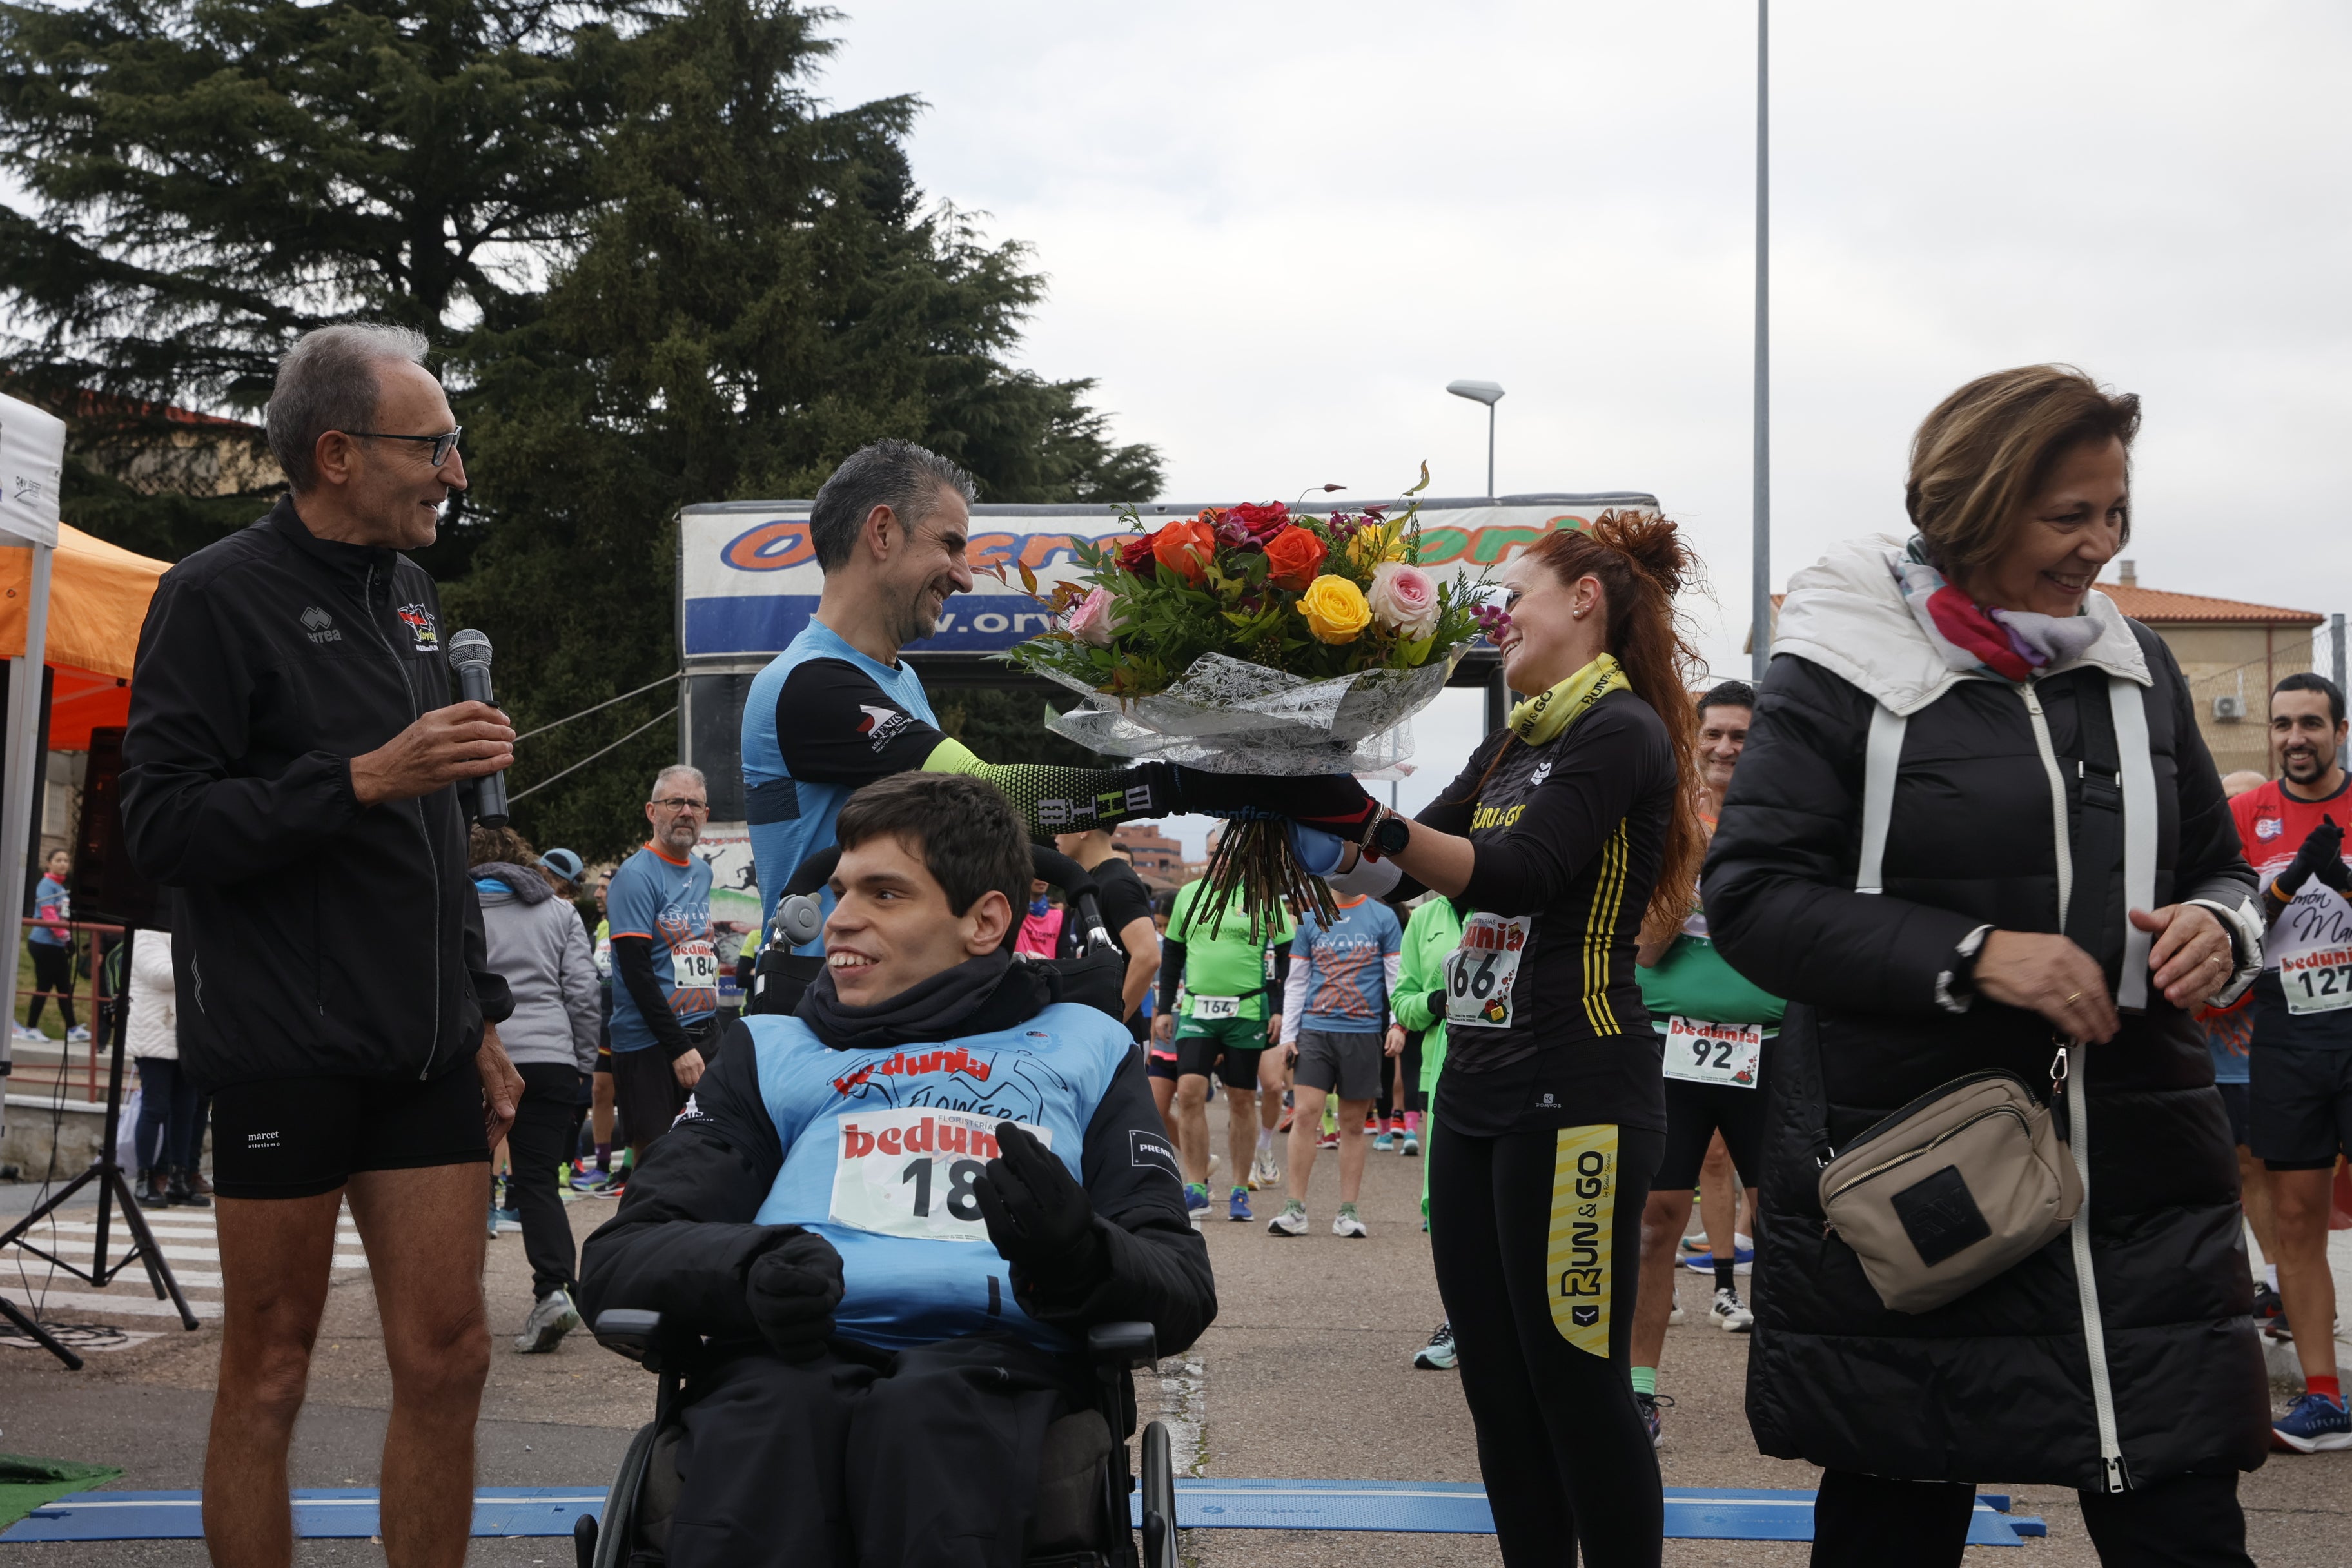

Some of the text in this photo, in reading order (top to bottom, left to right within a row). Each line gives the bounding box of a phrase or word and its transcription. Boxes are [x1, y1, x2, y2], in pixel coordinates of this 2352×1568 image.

[1533, 691, 1553, 712] GO
[870, 713, 903, 740] TEMIS
[1496, 811, 1506, 825] &
[684, 956, 714, 977] 184
[2281, 946, 2352, 972] beduni
[2298, 964, 2352, 998] 127
[1203, 1001, 1231, 1014] 164
[1692, 1038, 1733, 1070] 92
[248, 1130, 279, 1141] marcet
[844, 1117, 1002, 1159] bedun
[1560, 1151, 1603, 1297] RUN & GO
